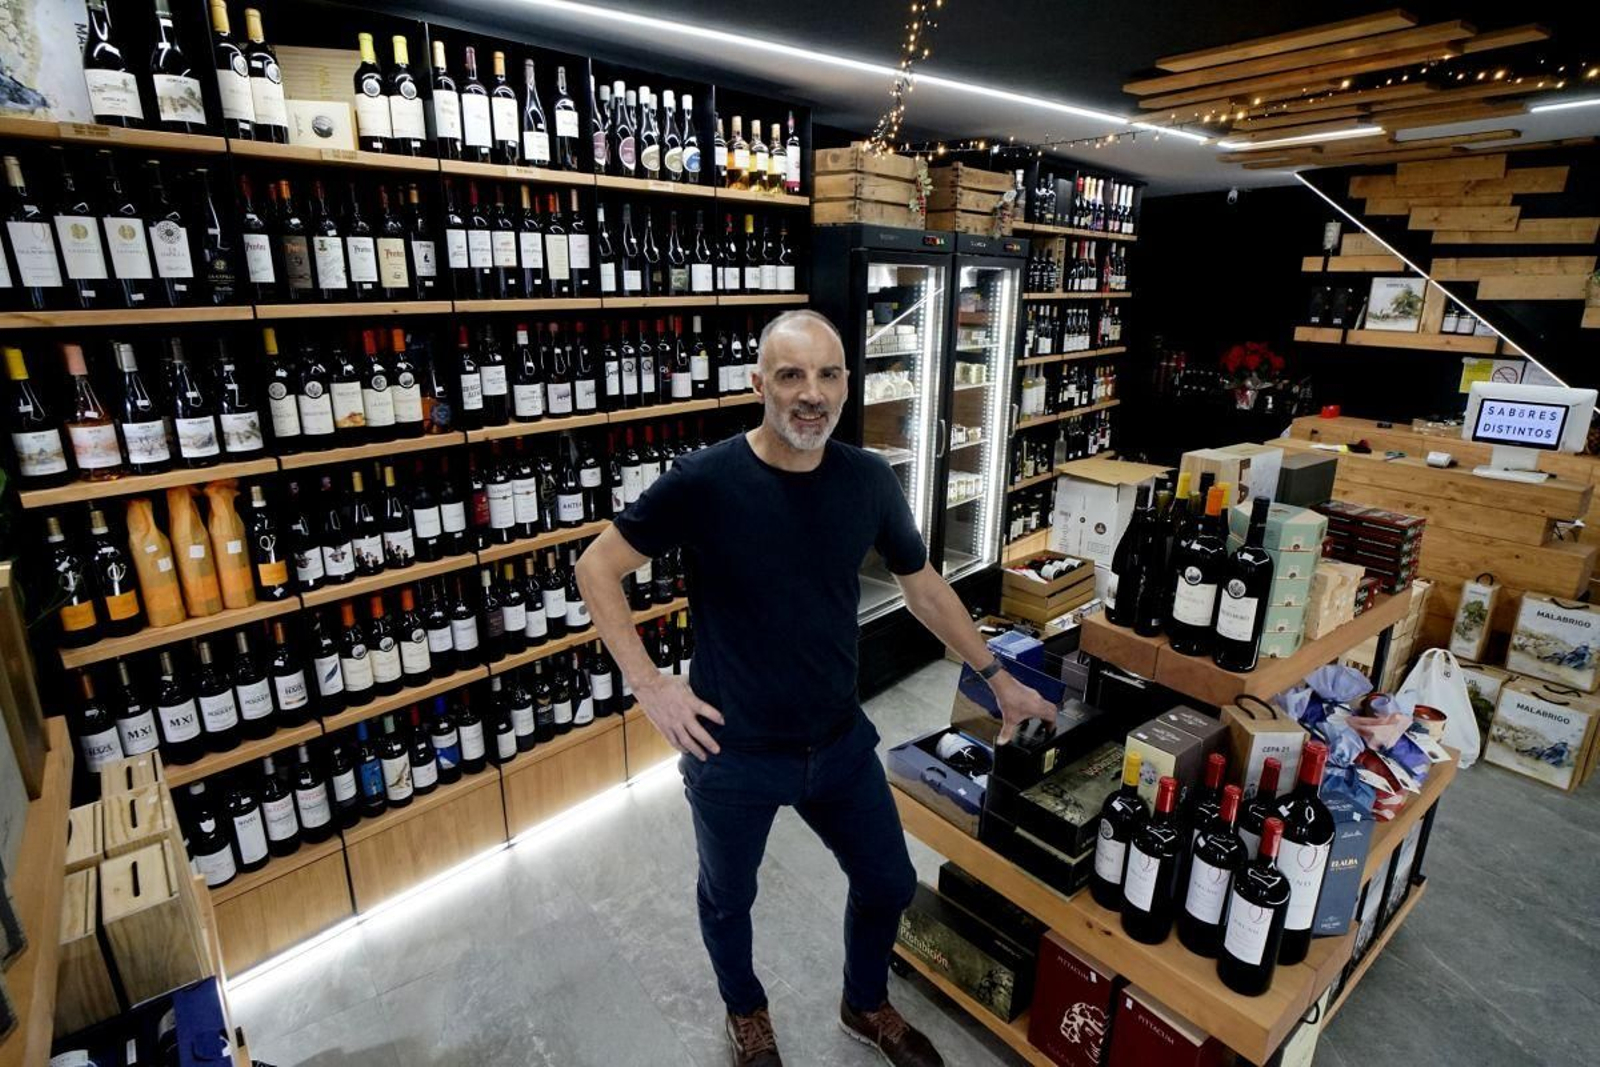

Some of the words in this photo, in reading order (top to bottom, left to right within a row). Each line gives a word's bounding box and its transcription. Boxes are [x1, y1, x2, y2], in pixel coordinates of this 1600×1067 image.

[1483, 423, 1552, 439] DISTINTOS
[1536, 610, 1592, 629] MALABRIGO
[1516, 702, 1571, 725] MALABRIGO
[1262, 746, 1280, 754] CEPA
[1281, 745, 1290, 753] 21
[1137, 1013, 1175, 1046] PITTACUM
